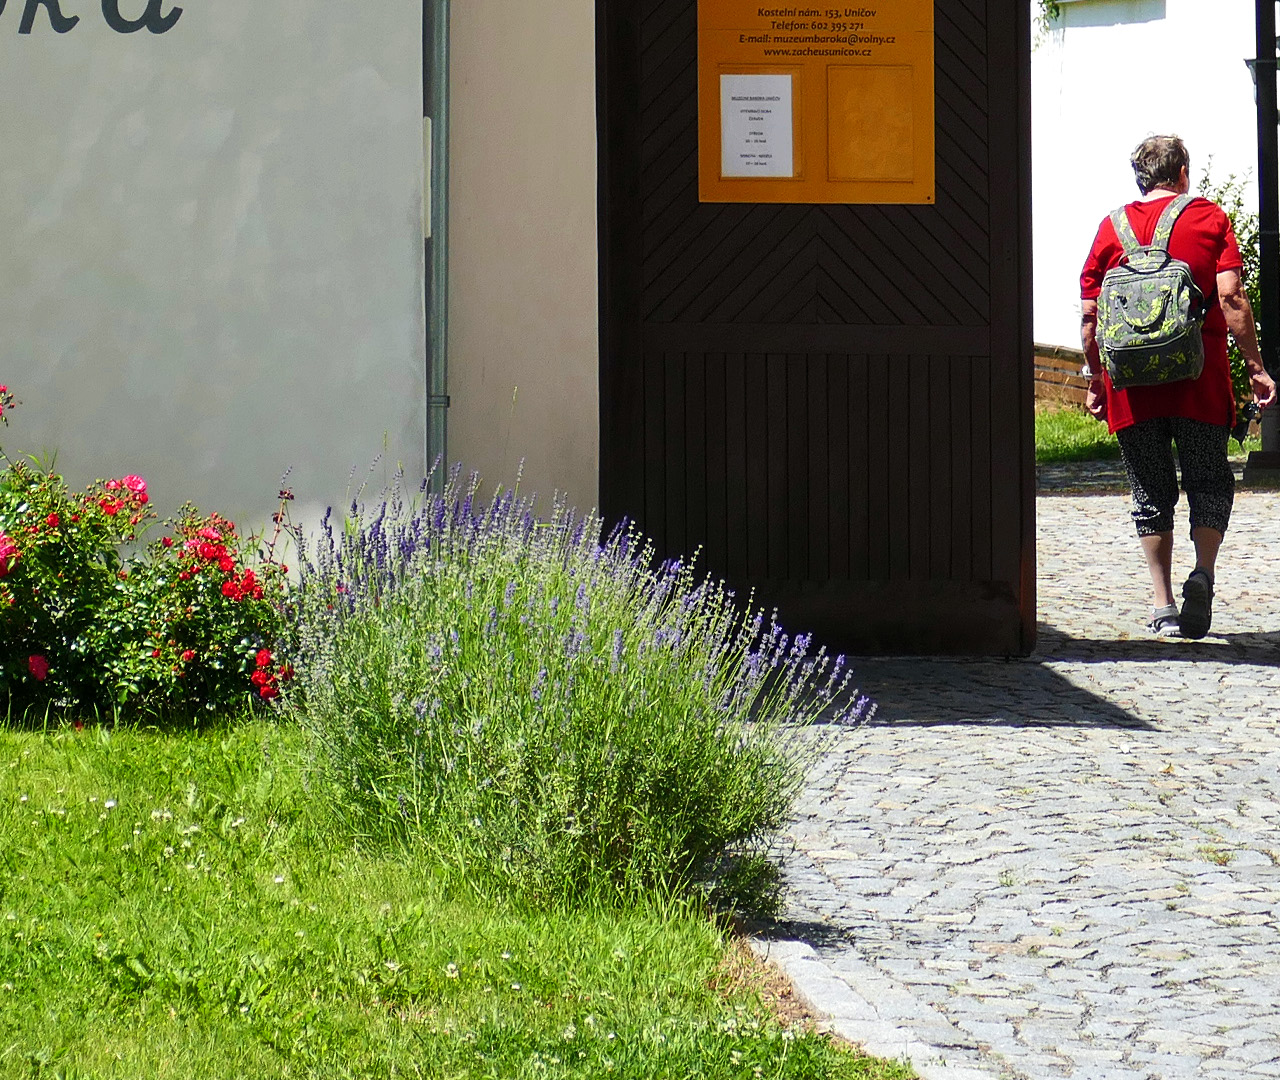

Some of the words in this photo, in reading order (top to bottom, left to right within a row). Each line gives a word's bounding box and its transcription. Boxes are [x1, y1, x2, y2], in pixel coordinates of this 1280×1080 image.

[757, 8, 796, 17] Kostelní
[798, 8, 822, 17] nám.
[825, 9, 842, 19] 153,
[844, 8, 877, 18] Uničov
[771, 21, 809, 32] Telefon:
[811, 21, 828, 30] 602
[831, 22, 847, 32] 395
[849, 22, 864, 31] 271
[739, 34, 771, 43] E-mail:
[773, 33, 896, 46] muzeumbaroka@volny.cz
[764, 47, 872, 56] www.zacheusunicov.cz
